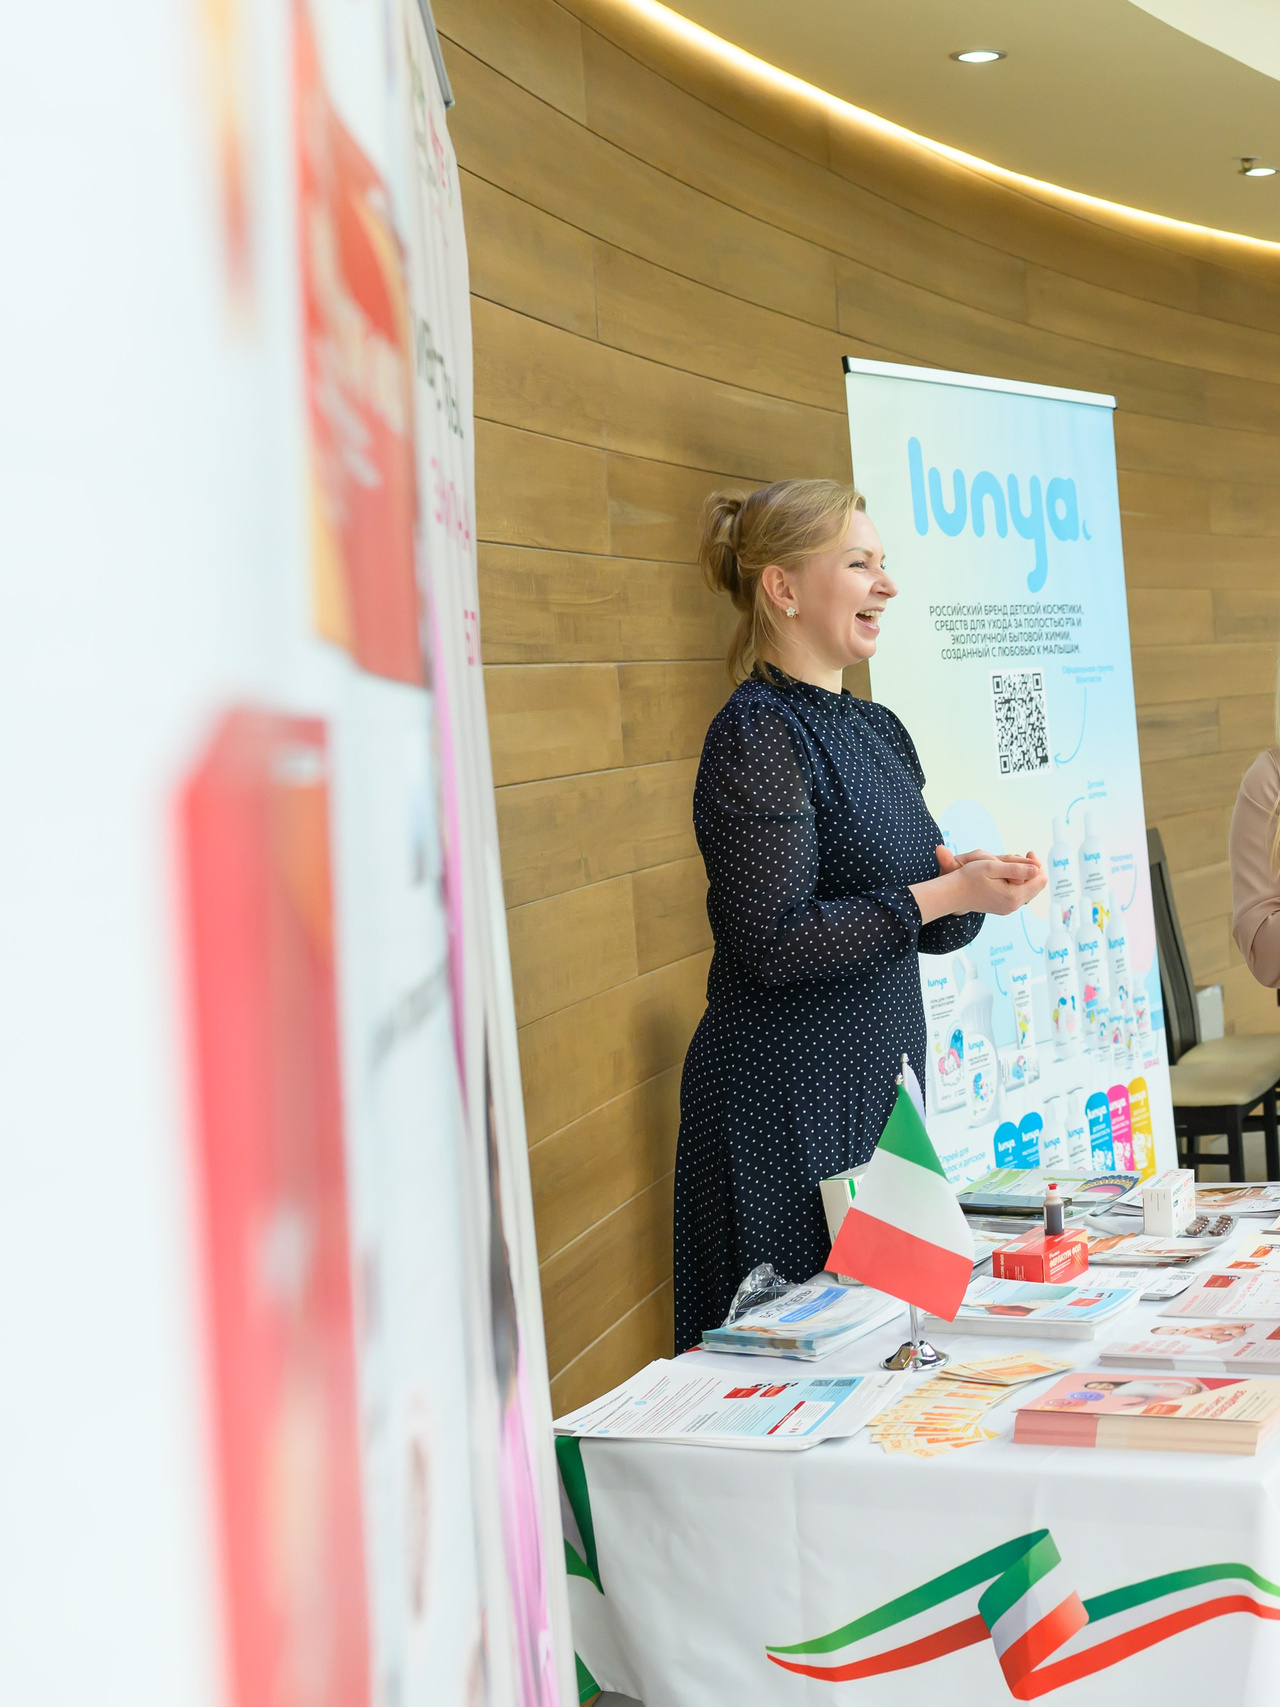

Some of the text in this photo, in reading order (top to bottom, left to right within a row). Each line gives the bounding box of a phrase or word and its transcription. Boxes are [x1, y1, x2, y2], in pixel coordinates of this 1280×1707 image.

[908, 436, 1080, 593] lunya
[930, 602, 1084, 617] РОССИЙСКИЙ БРЕНД ДЕТСКОЙ КОСМЕТИКИ,
[934, 618, 1082, 632] СРЕДСТВ ДЛЯ УХОДА ЗА ПОЛОСТЬЮ РТА И
[951, 630, 1008, 644] ЭКОЛОГИЧНОЙ
[1009, 629, 1044, 642] БЫТОВОЙ
[941, 645, 990, 660] СОЗДАННЫЙ
[992, 646, 997, 657] С
[998, 646, 1036, 657] ЛЮБОВЬЮ
[1036, 646, 1042, 655] К
